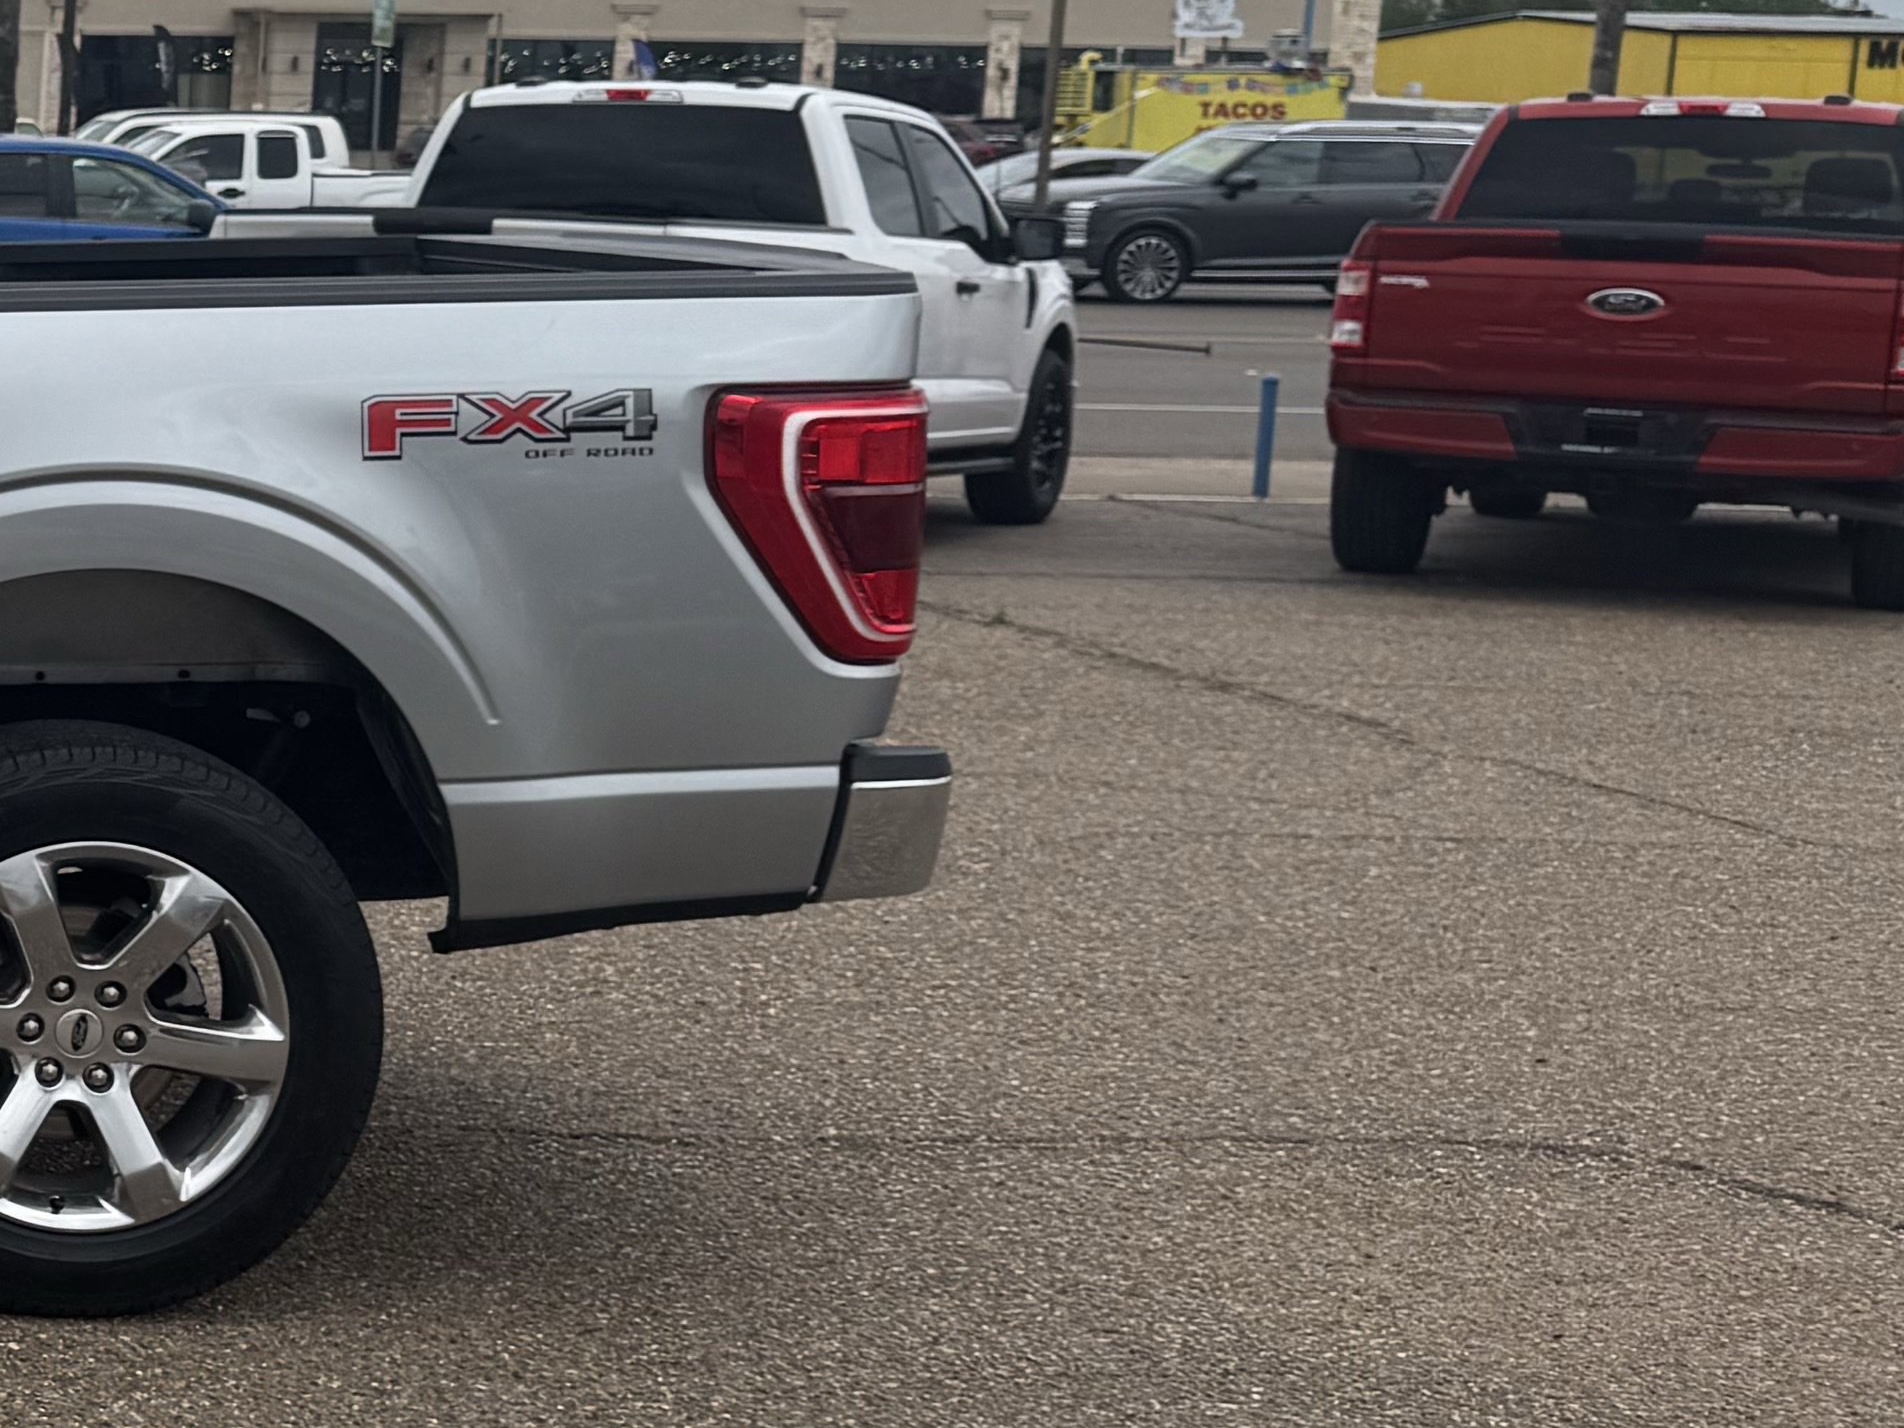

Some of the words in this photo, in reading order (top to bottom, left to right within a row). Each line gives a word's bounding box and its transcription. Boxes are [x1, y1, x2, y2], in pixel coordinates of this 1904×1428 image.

[1198, 100, 1287, 120] TACOS
[360, 387, 658, 462] FX4
[524, 448, 576, 460] OFF
[586, 446, 654, 458] ROAD
